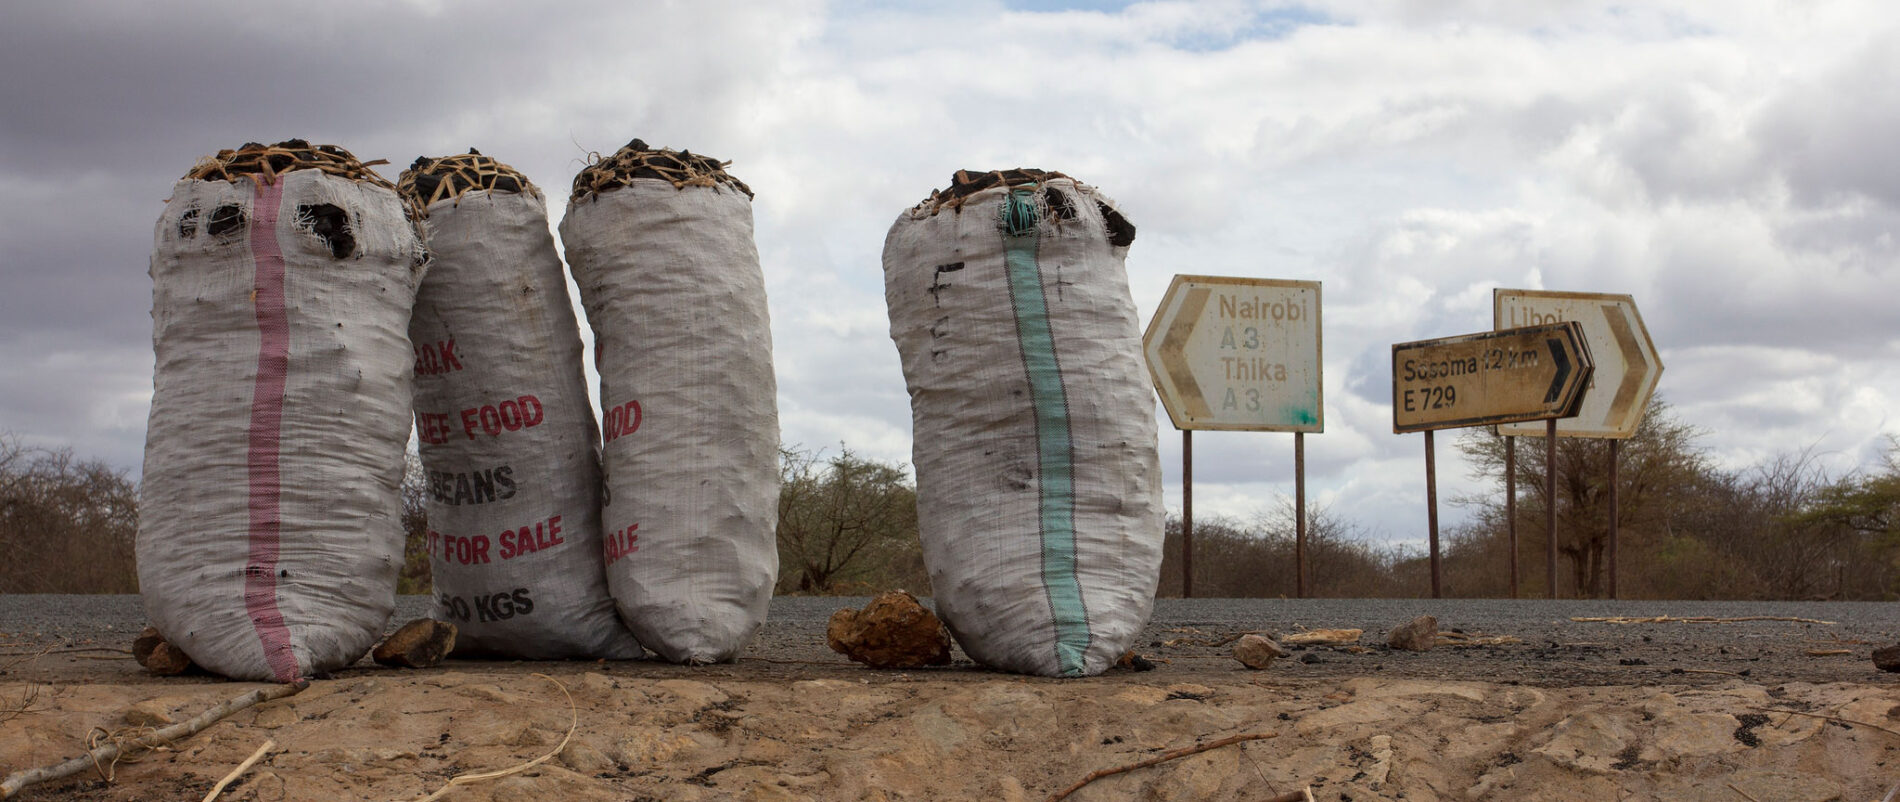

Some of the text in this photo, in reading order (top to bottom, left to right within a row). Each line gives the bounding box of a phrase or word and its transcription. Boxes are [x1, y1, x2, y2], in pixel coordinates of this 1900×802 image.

[1219, 294, 1308, 322] Nairobi
[1220, 325, 1260, 350] A 3
[1220, 356, 1288, 382] Thika
[1404, 346, 1539, 382] Sosoma 12 km
[1222, 387, 1260, 412] A 3
[1404, 385, 1457, 412] E 729
[461, 394, 544, 441] FOOD
[429, 465, 517, 506] BEANS
[444, 534, 491, 566] FOR
[499, 515, 564, 560] SALE
[473, 587, 535, 624] KGS
